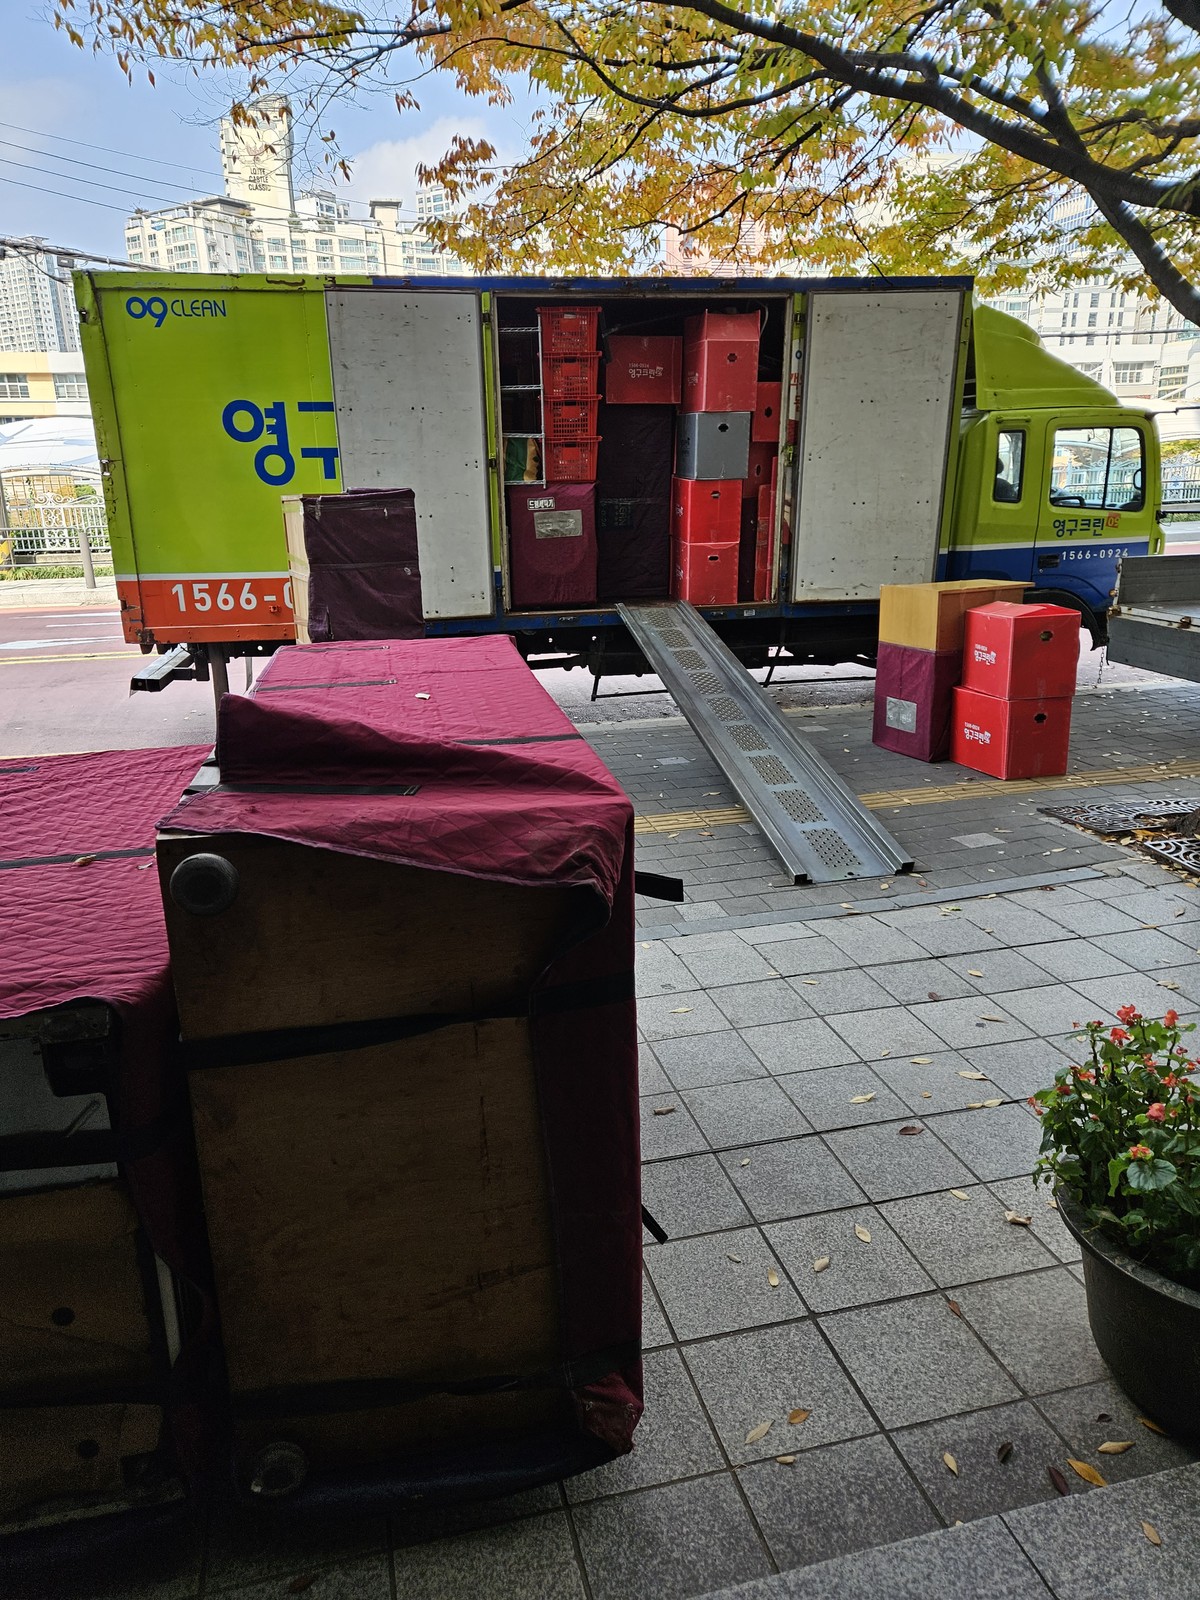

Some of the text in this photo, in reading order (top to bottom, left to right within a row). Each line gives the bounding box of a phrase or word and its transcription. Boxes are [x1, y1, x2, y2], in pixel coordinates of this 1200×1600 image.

[248, 175, 269, 183] CASTLE
[125, 296, 227, 328] 09 CLEAN
[1052, 518, 1105, 538] 영구크린
[1061, 548, 1129, 560] 1566-0924
